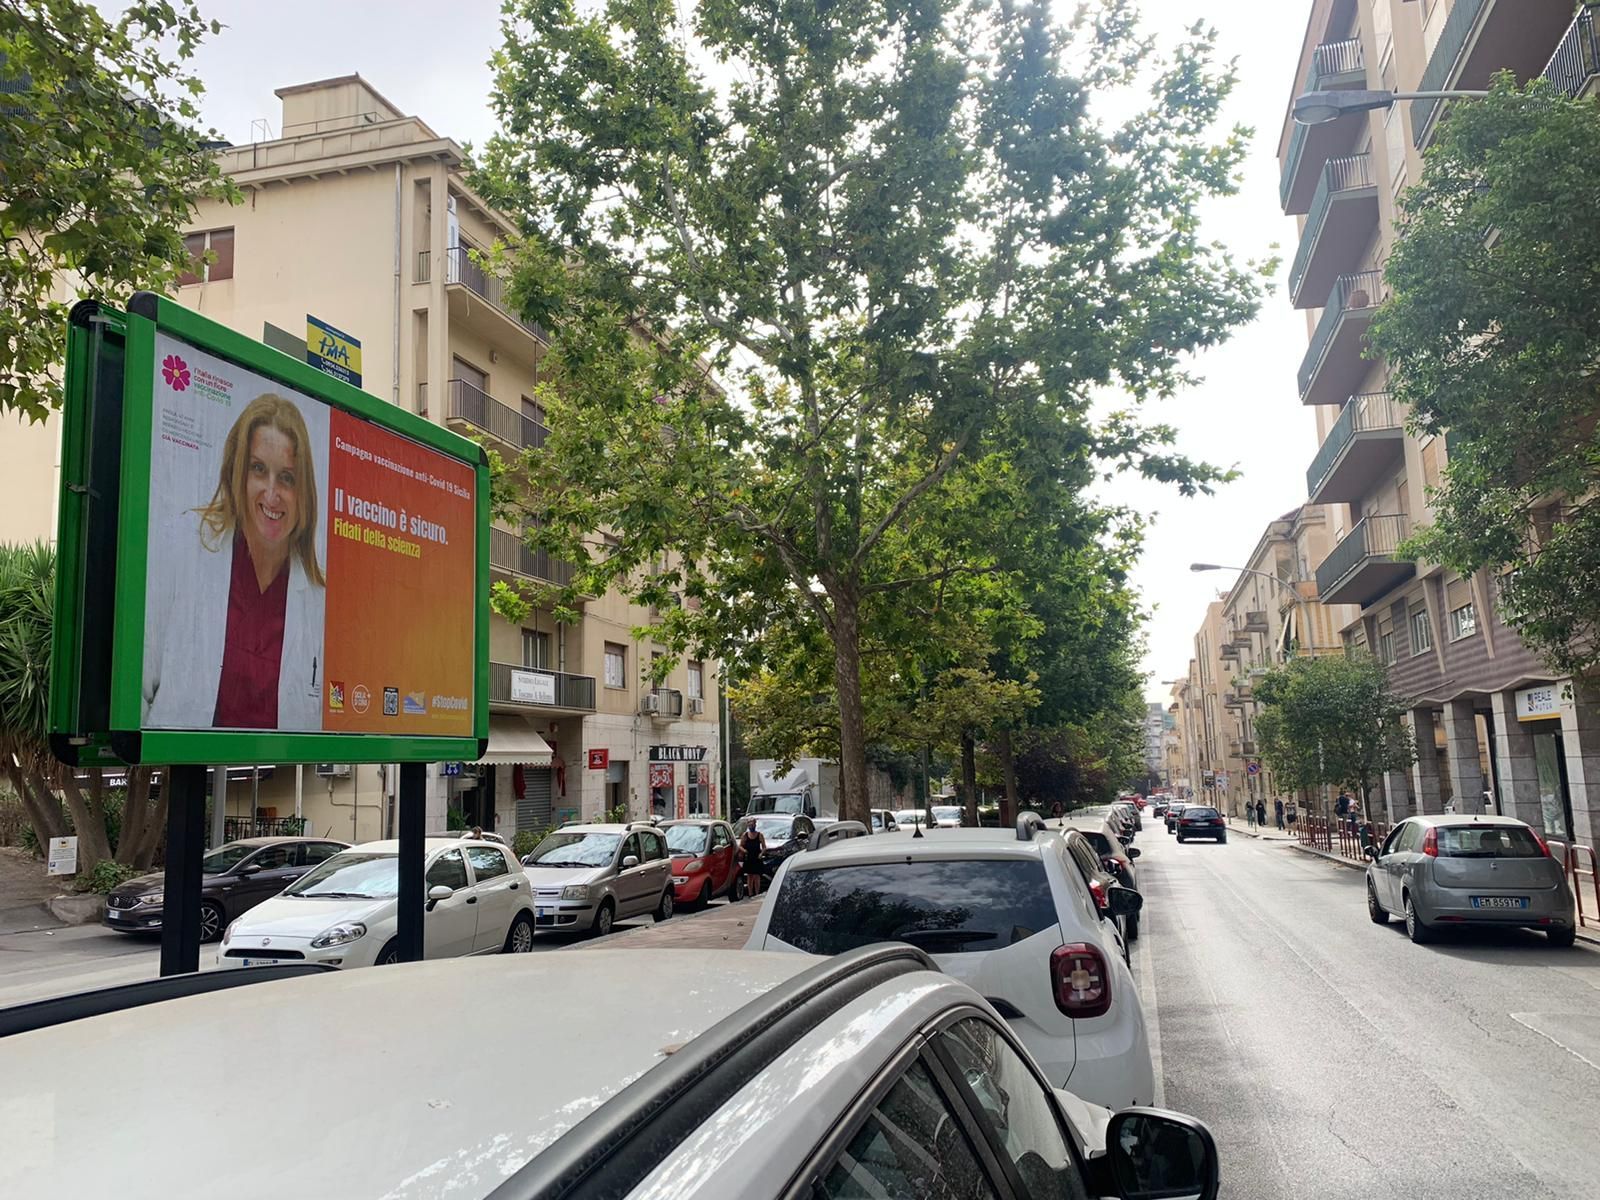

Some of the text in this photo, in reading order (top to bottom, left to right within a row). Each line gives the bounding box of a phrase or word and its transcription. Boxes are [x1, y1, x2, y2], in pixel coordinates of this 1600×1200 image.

[172, 437, 200, 451] VACCINATA
[335, 437, 372, 461] Campagna
[373, 455, 414, 478] vaccinazione
[415, 469, 446, 490] anti-Covid
[454, 484, 471, 500] Sicilia
[335, 487, 448, 545] Il vaccino è sicuro.
[334, 517, 421, 559] Fidati della scienza
[1534, 690, 1552, 702] REALE
[658, 747, 681, 760] BLACK
